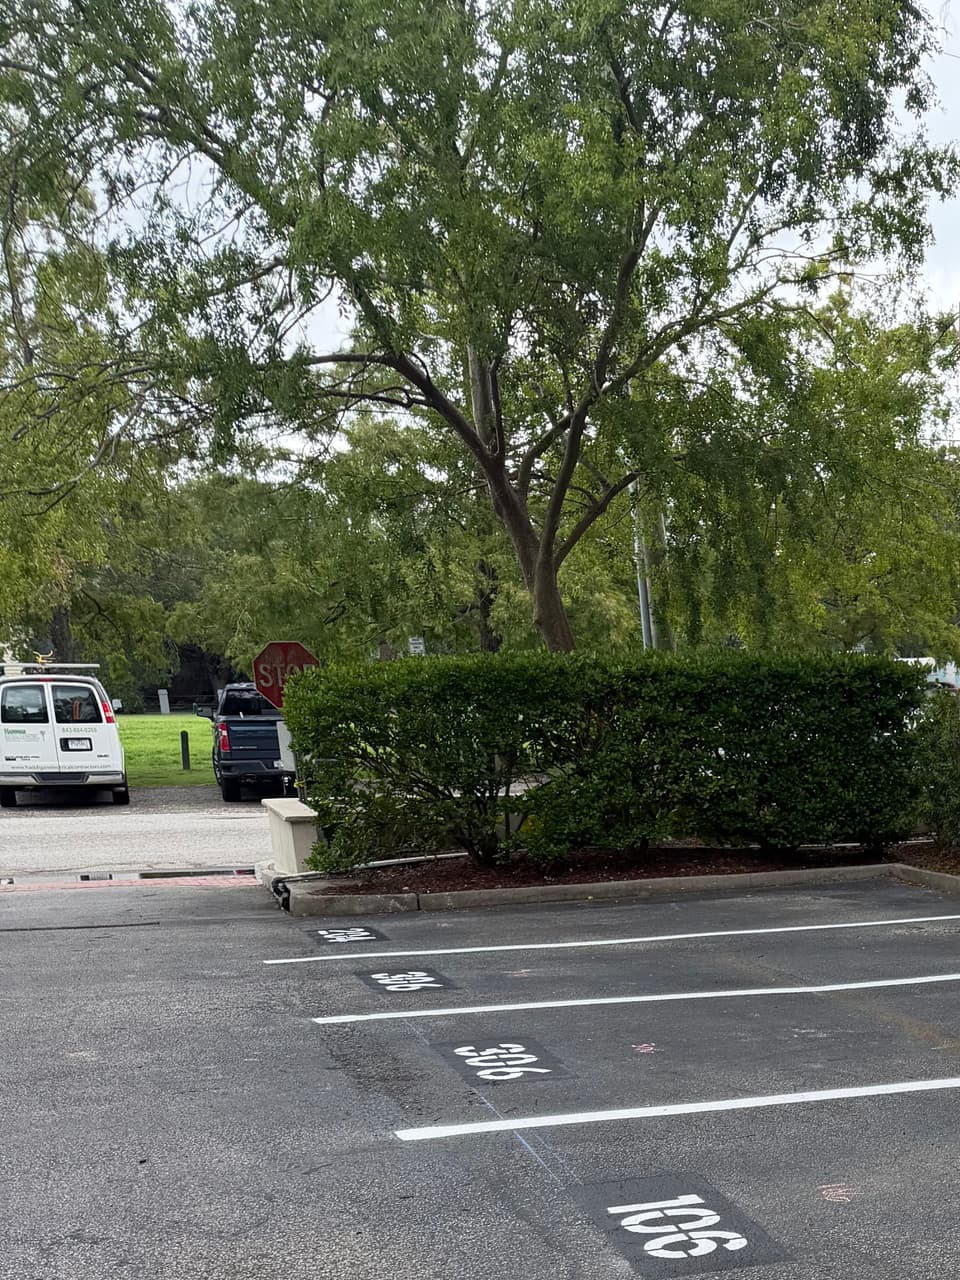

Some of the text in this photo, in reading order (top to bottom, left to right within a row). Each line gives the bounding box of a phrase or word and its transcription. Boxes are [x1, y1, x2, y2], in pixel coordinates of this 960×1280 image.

[258, 663, 317, 688] ST
[371, 971, 444, 992] 306
[453, 1043, 552, 1081] 306
[606, 1194, 748, 1259] 106
